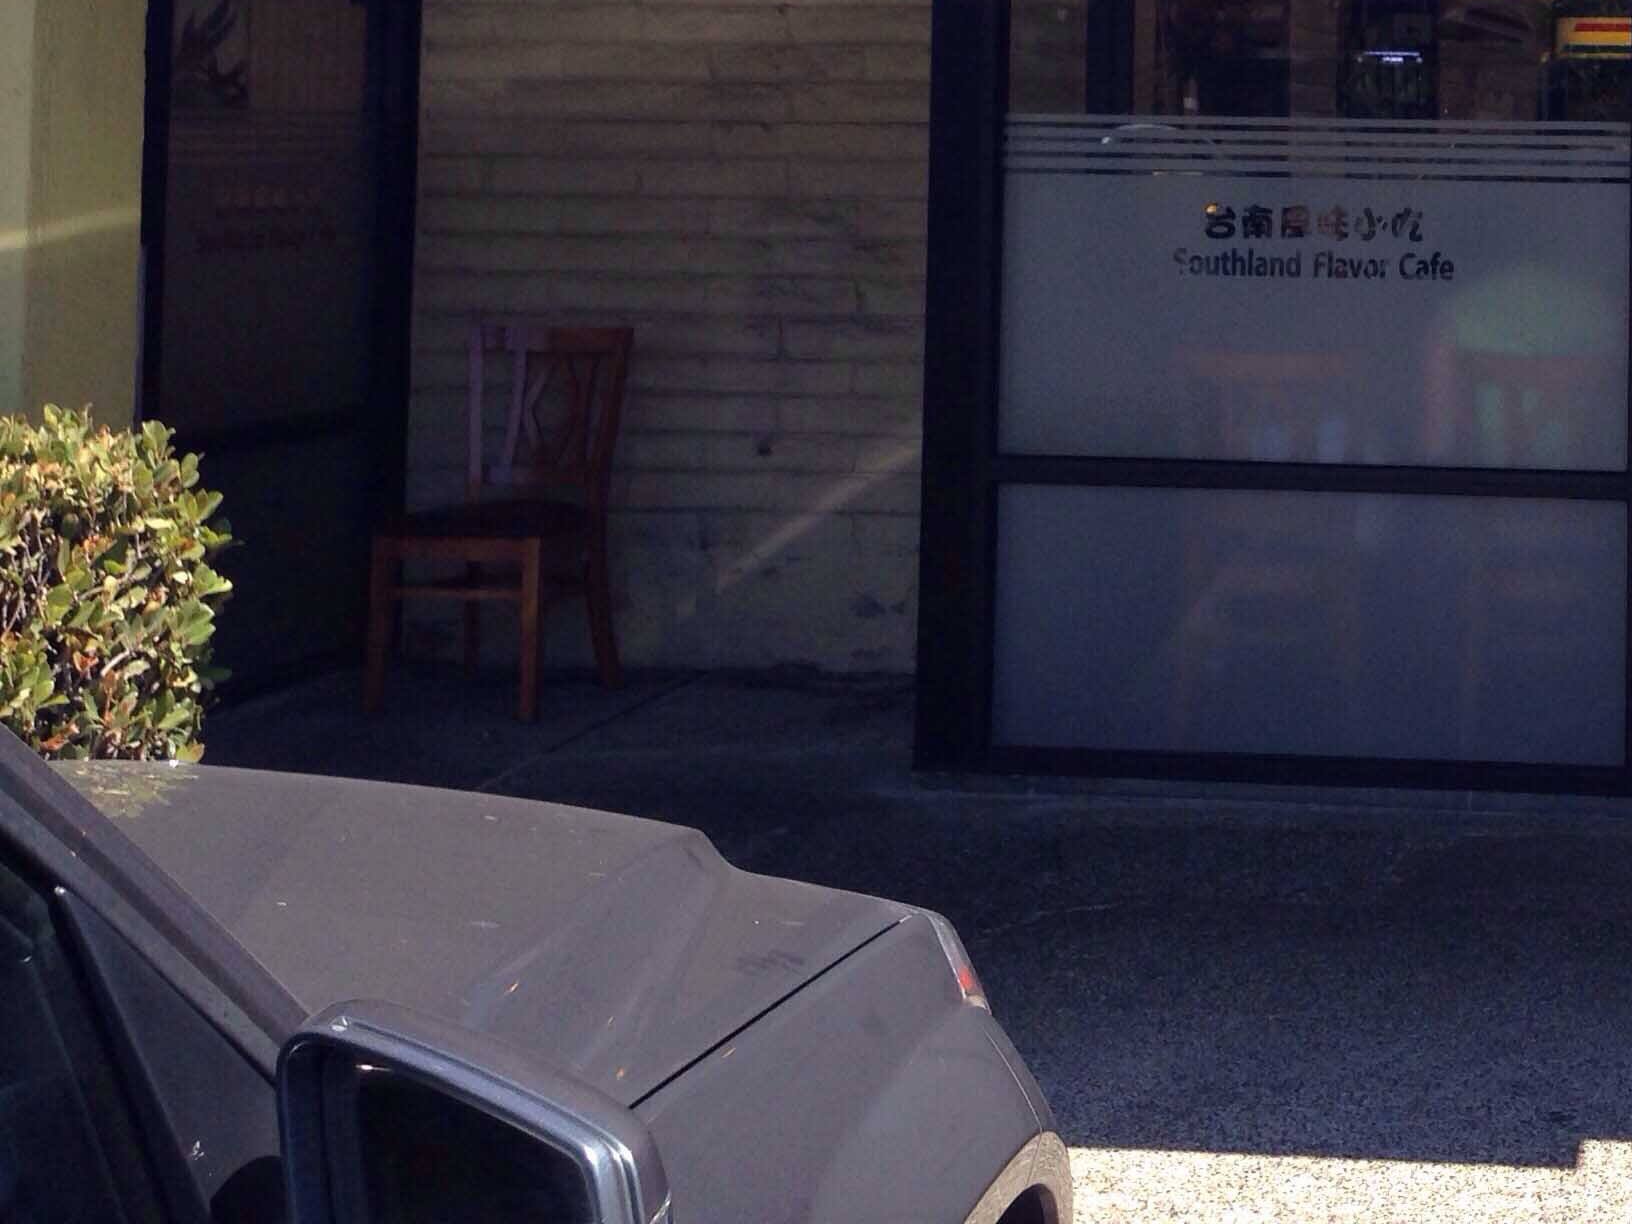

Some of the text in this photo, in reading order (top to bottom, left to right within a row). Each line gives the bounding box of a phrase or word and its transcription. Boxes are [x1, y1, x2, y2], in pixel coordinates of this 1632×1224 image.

[1173, 247, 1455, 281] Southland Flavor Cafe
